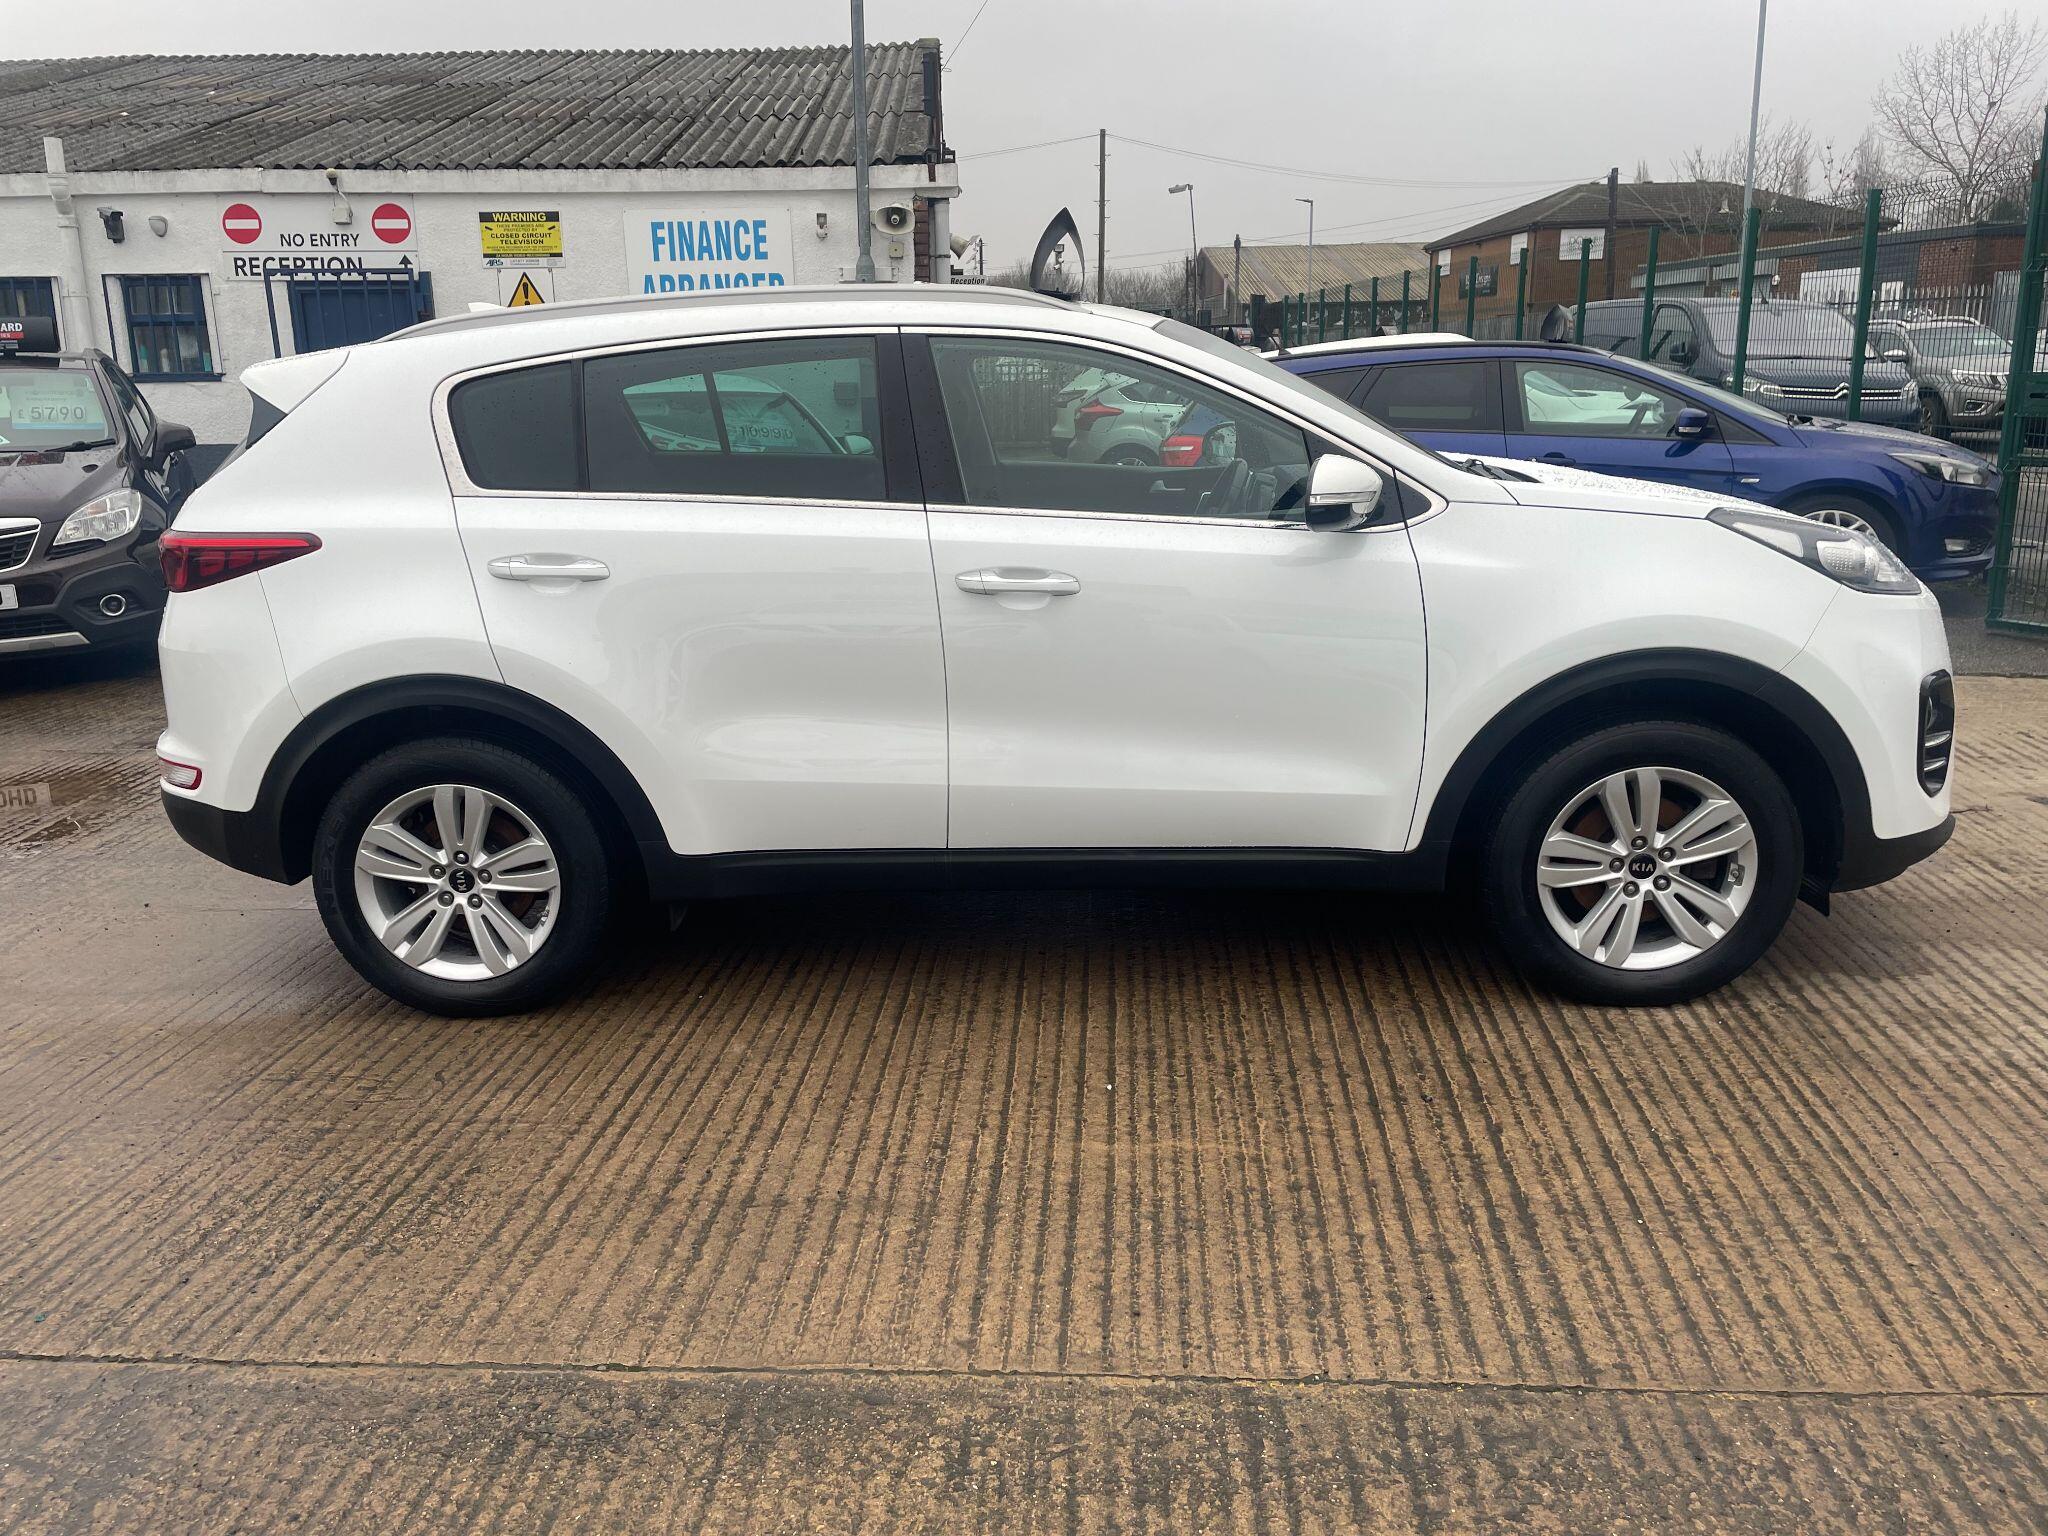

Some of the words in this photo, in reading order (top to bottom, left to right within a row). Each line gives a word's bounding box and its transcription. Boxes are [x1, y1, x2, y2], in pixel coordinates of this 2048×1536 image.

[492, 212, 547, 222] WARNING
[280, 233, 304, 247] NO
[310, 233, 360, 247] ENTRY
[650, 219, 769, 262] FINANCE
[233, 256, 363, 277] RECEPTION
[950, 277, 985, 285] Reception
[0, 322, 23, 332] ARD
[1631, 862, 1655, 872] KIA
[455, 870, 467, 891] KIA
